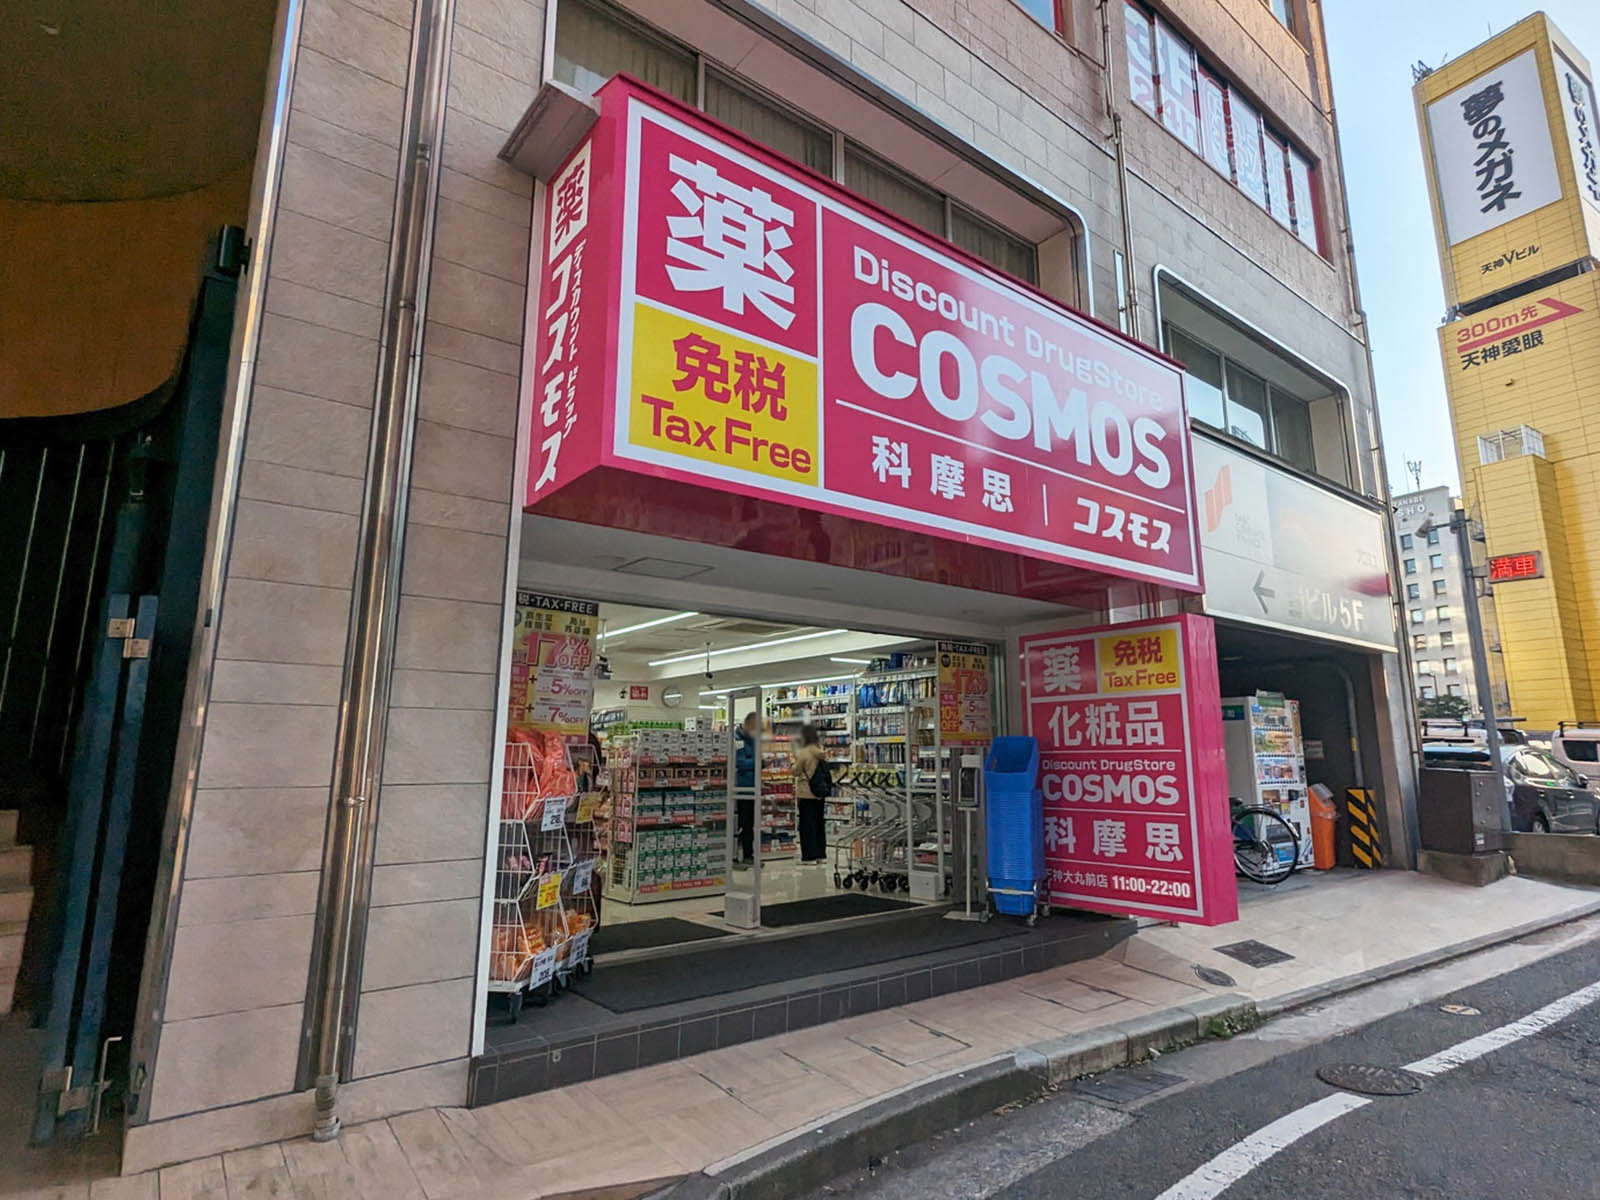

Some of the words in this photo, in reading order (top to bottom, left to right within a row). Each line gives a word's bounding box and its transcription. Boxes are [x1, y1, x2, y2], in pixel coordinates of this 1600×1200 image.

[1460, 80, 1523, 214] 夢のメガネ
[555, 158, 585, 246] 薬
[664, 152, 797, 331] 薬
[1480, 244, 1540, 275] 天神Vビル
[853, 245, 1015, 348] Discount
[1024, 326, 1164, 412] DrugStore
[1456, 303, 1539, 345] 300m先
[534, 253, 573, 492] コスモス
[1460, 328, 1544, 371] 天神愛眼
[671, 331, 788, 422] 免税
[850, 302, 1171, 490] COSMOS
[641, 394, 718, 453] Tax
[724, 416, 812, 474] Free
[1073, 497, 1172, 554] コスモス
[1489, 555, 1538, 580] 満車
[1042, 646, 1081, 693] 薬
[1113, 636, 1163, 667] 免税
[1104, 670, 1134, 688] Tax
[1135, 669, 1177, 687] Free
[1048, 701, 1165, 747] 化粧品
[1042, 759, 1097, 771] Discount
[1100, 759, 1176, 772] DrugStore
[1042, 773, 1180, 806] COSMOS
[1112, 875, 1191, 898] 11:00-22:00
